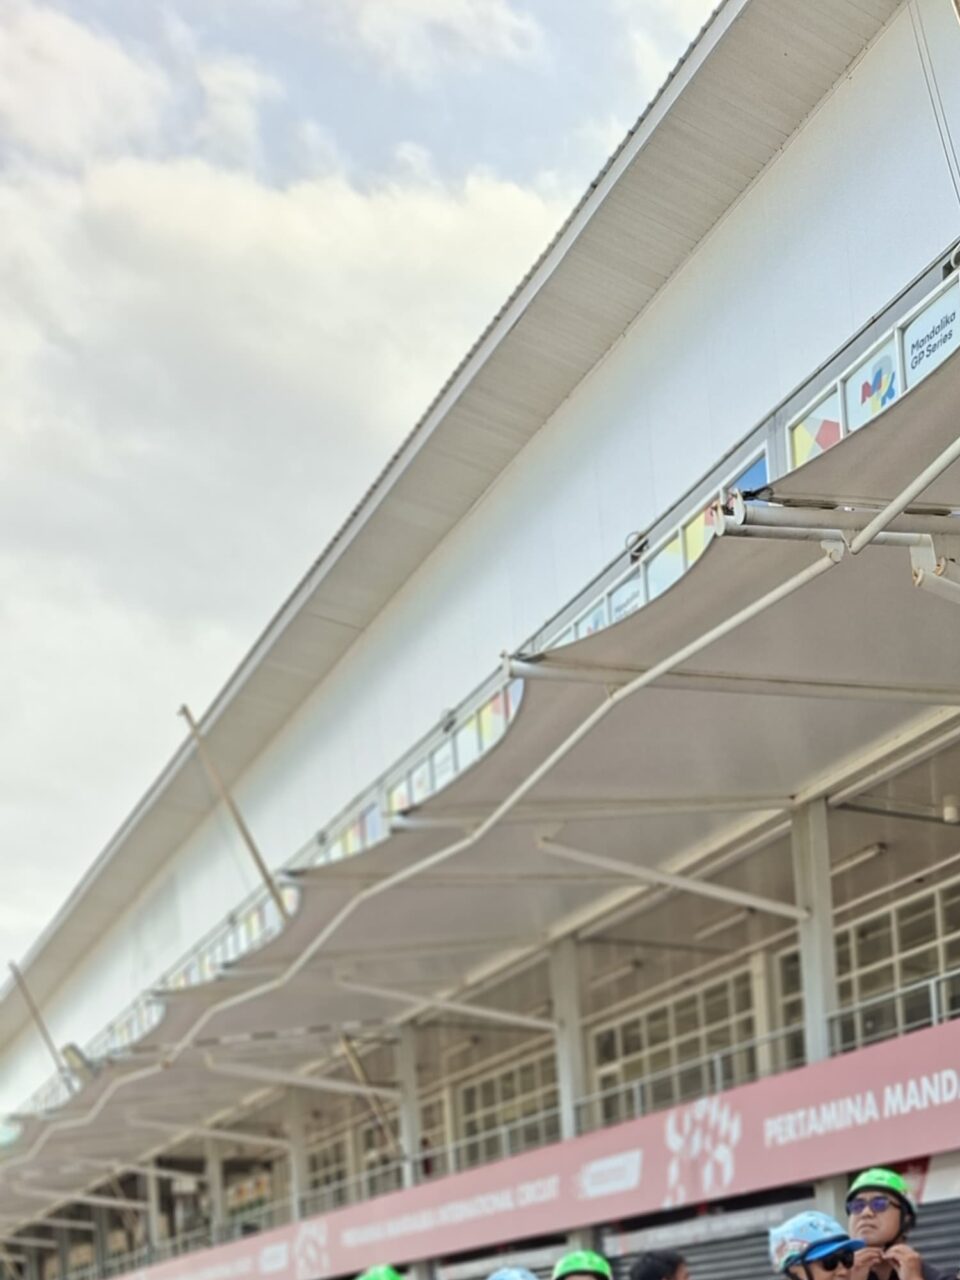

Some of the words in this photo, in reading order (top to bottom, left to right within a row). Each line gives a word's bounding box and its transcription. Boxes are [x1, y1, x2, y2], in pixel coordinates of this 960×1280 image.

[910, 352, 926, 370] GP
[926, 329, 953, 358] Series
[911, 311, 956, 355] Mandalika
[763, 1090, 879, 1148] PERTAMINA
